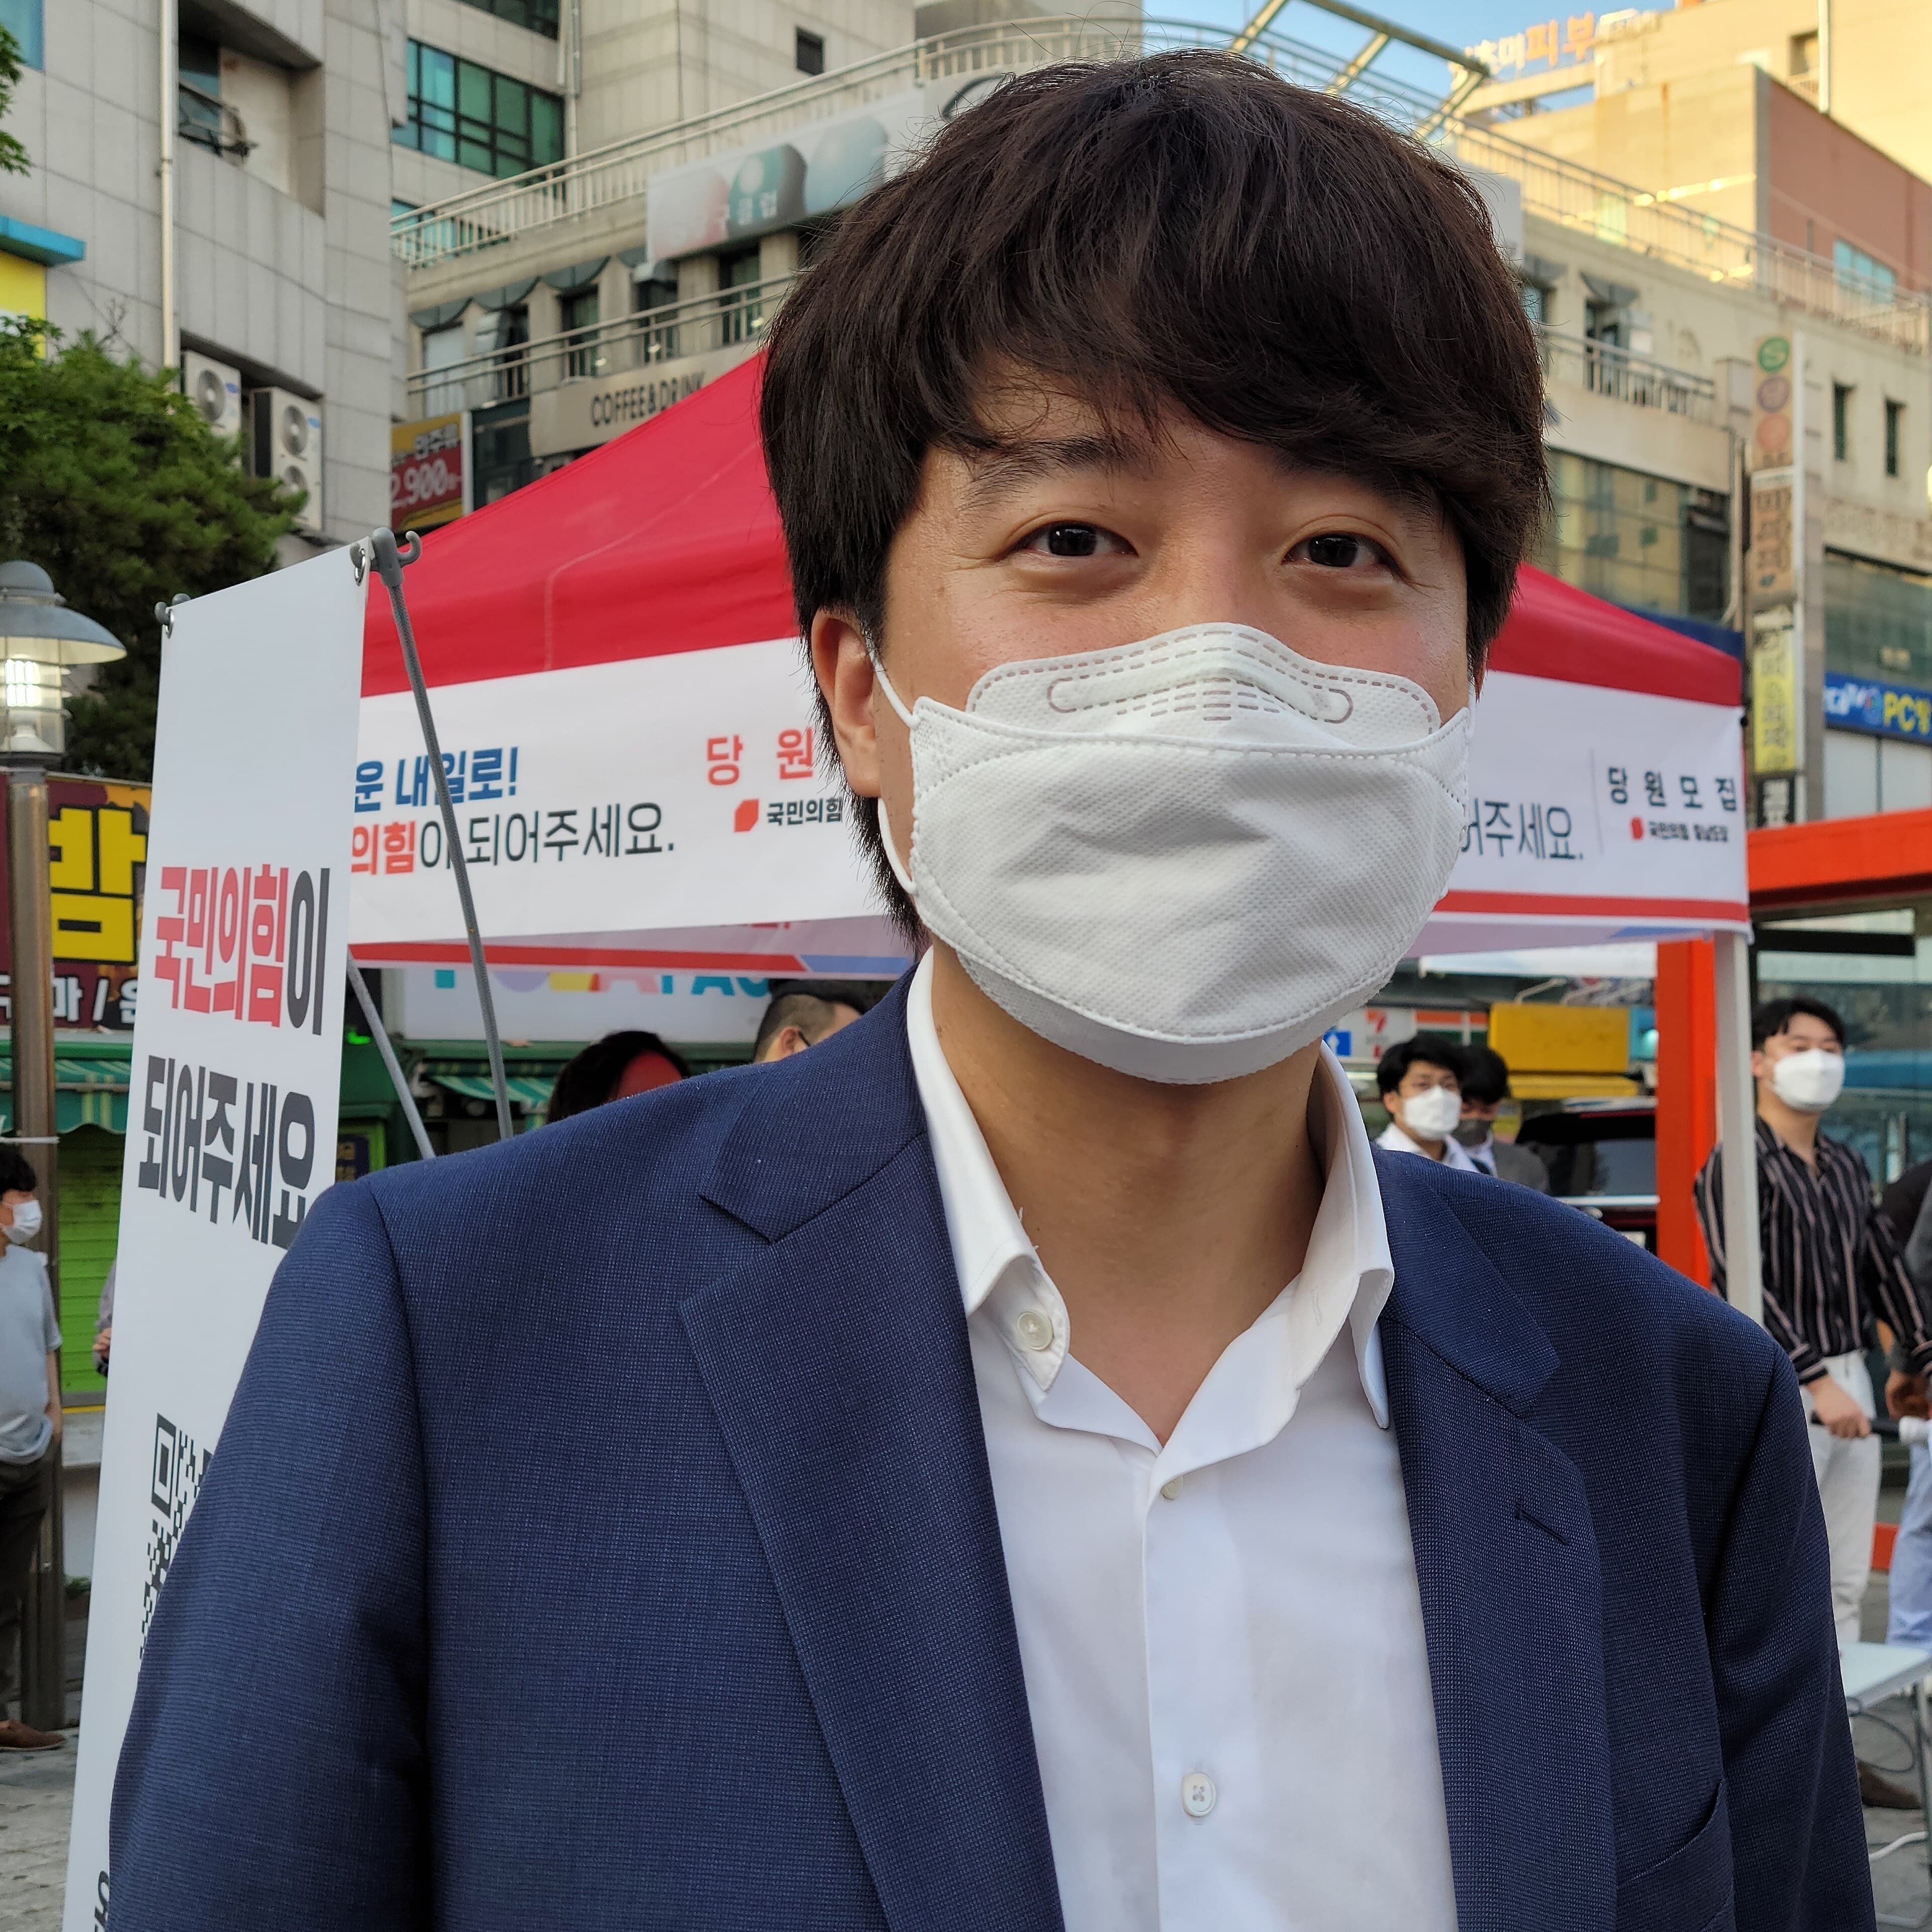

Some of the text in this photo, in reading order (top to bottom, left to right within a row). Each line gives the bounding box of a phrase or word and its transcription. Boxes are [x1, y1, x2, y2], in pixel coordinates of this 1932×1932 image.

[466, 802, 674, 866] 되어주세요.
[766, 797, 842, 826] 국민의힘
[154, 863, 331, 1036] 국민의힘이
[137, 1054, 316, 1251] 되어주세요
